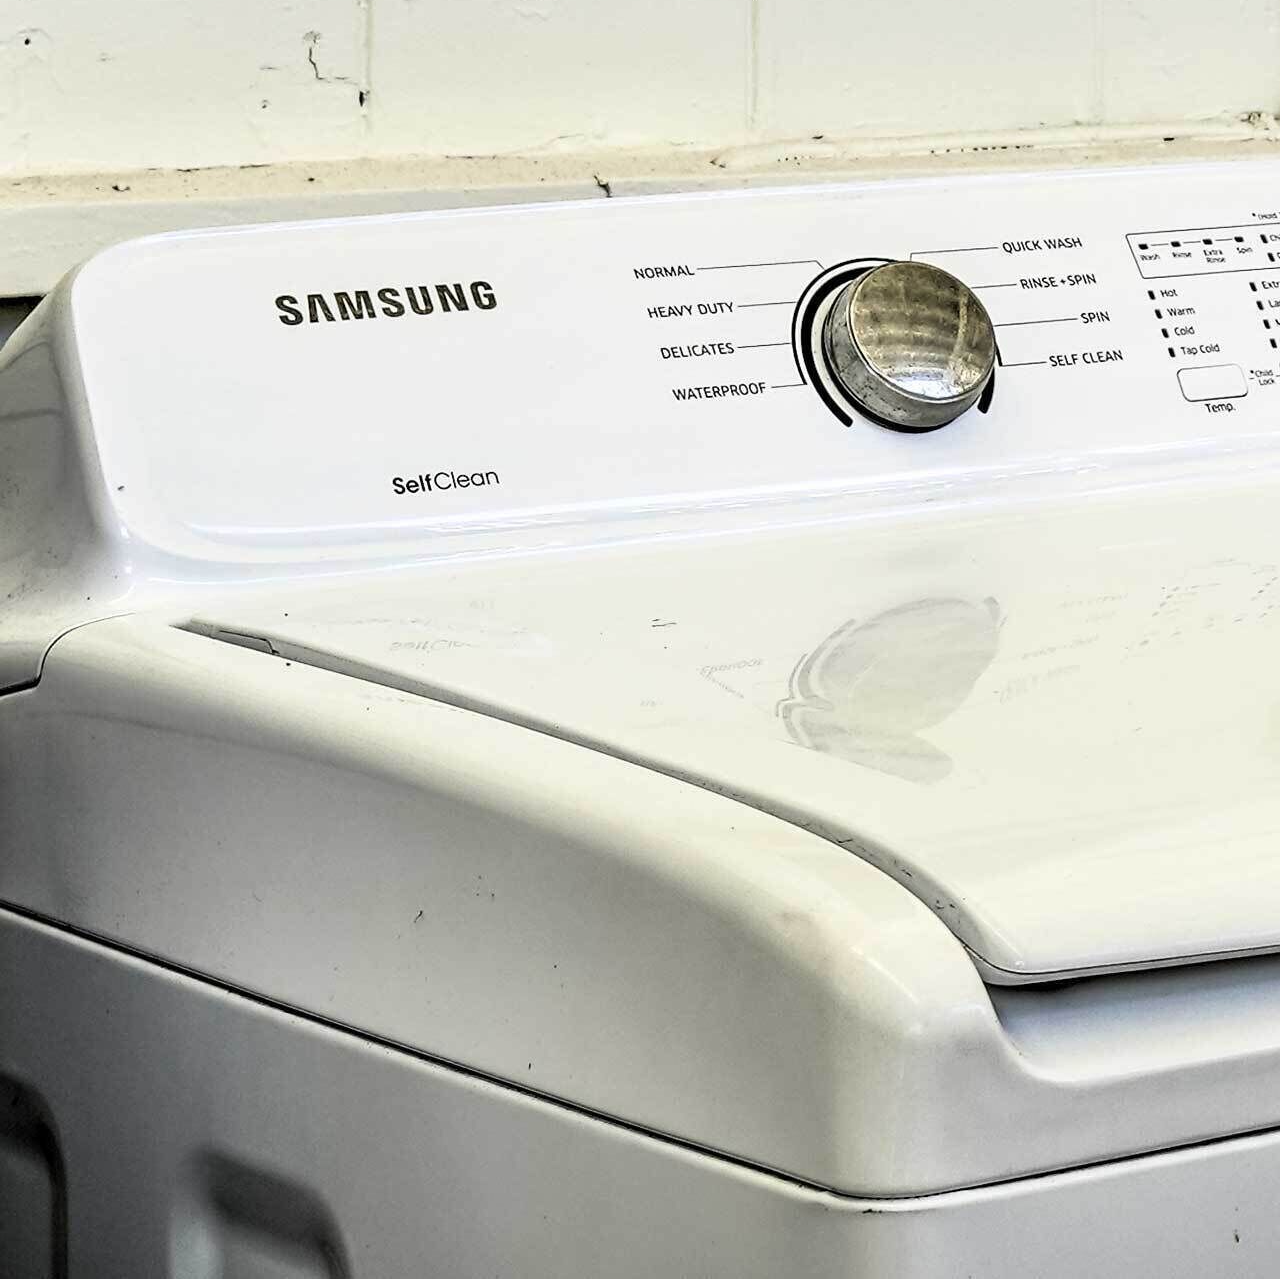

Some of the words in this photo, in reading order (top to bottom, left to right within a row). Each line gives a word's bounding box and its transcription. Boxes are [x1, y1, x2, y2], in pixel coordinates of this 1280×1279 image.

[1002, 240, 1043, 254] QUICK
[1043, 237, 1083, 249] WASH
[1140, 253, 1160, 262] Wash
[1203, 249, 1223, 257] Extra
[633, 265, 695, 280] NORMAL
[1020, 277, 1059, 289] RINSE
[1160, 288, 1179, 298] Hot
[275, 281, 497, 326] SAMSUNG
[647, 305, 693, 318] HEAVY
[697, 302, 734, 315] DUTY
[1080, 311, 1111, 324] SPIN
[1167, 306, 1196, 317] Warm
[1174, 326, 1195, 336] Cold
[660, 342, 735, 359] DELICATES
[1180, 346, 1198, 356] Tap
[1200, 343, 1220, 354] Cold
[1049, 354, 1078, 367] SELF
[1082, 350, 1123, 364] CLEAN
[1258, 377, 1275, 385] Lock
[672, 382, 766, 401] WATERPROOF
[1205, 402, 1236, 413] Temp.
[392, 471, 500, 495] SelfClean
